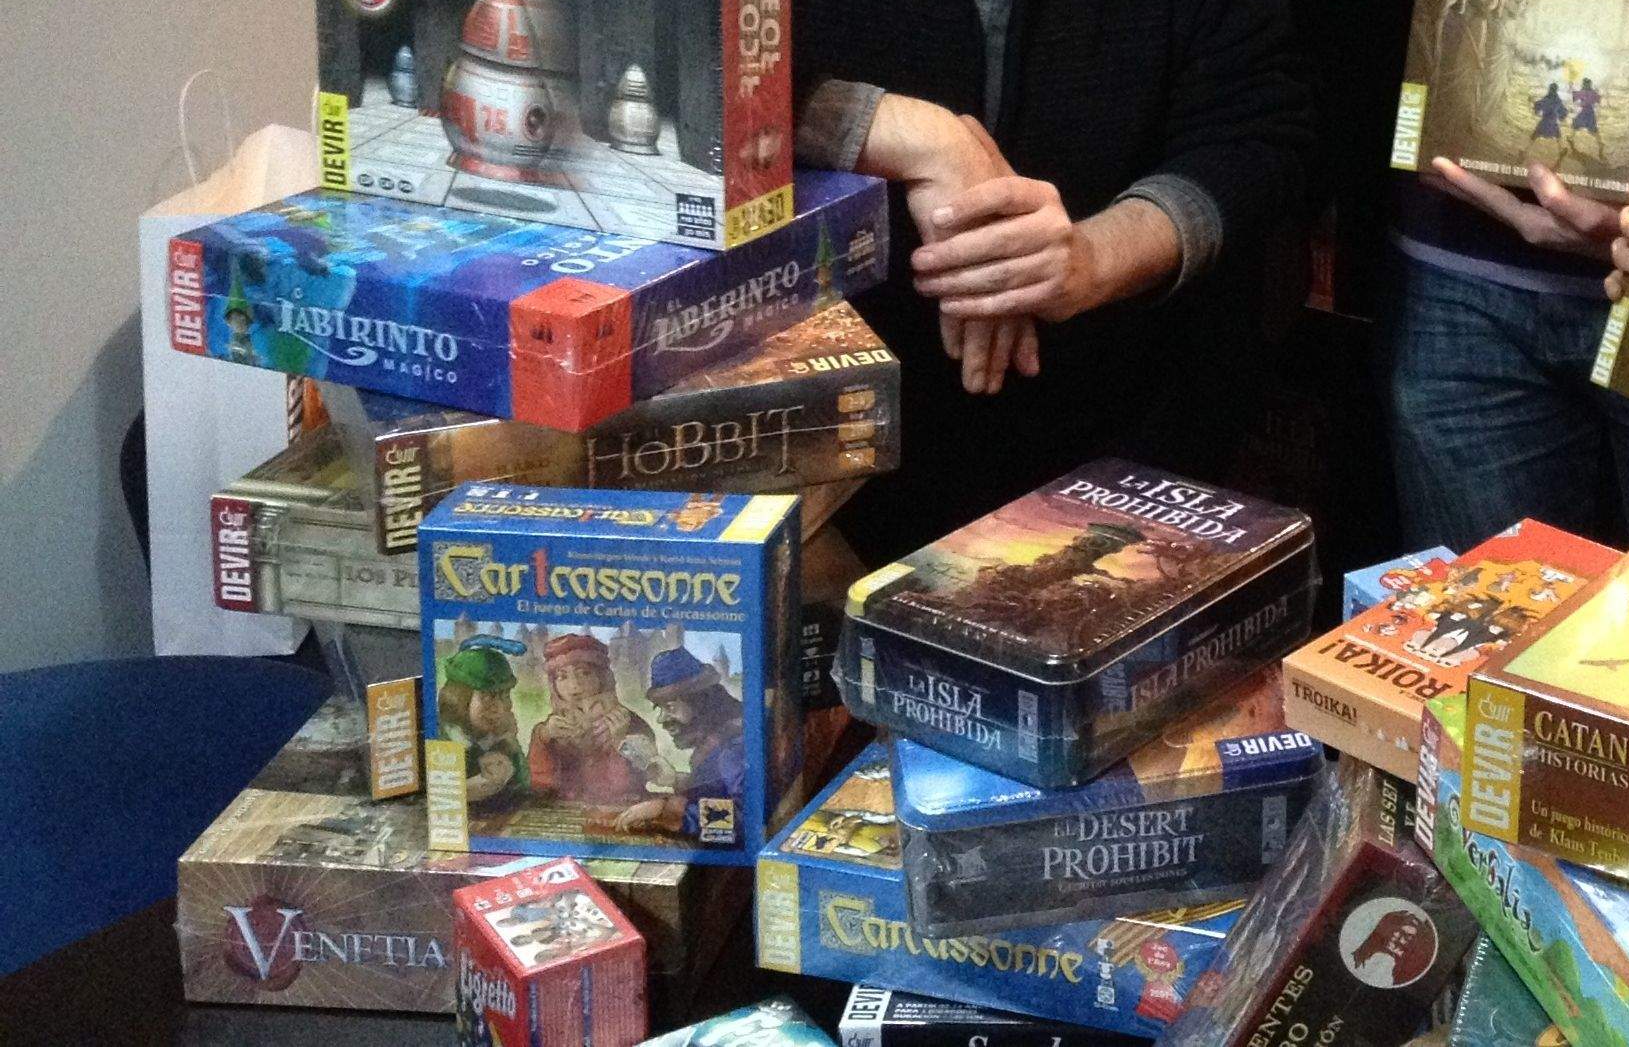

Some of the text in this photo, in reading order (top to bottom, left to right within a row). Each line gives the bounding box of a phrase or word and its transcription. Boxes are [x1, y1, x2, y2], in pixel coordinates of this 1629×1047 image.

[322, 118, 346, 188] DEVIR
[1394, 104, 1422, 166] DEVIR
[173, 265, 199, 348] DEVIR
[276, 295, 459, 364] LABIRINTO
[808, 348, 894, 373] DEVIR
[587, 405, 804, 488] HOBBIT
[381, 465, 423, 550] DEVIR
[1059, 480, 1247, 544] PROHIBIDA
[1118, 475, 1245, 520] LA ISLA
[220, 530, 249, 603] DEVIR
[517, 600, 530, 612] El
[574, 603, 590, 614] de
[594, 604, 637, 618] Cartas
[642, 606, 656, 618] de
[662, 607, 746, 622] Carcassonne
[909, 675, 983, 718] LA ISLA
[1292, 678, 1358, 721] TROIKA!
[1318, 638, 1453, 699] ROIKA!
[379, 709, 416, 789] DEVIR
[892, 692, 1000, 749] PROHIBIDA
[1244, 732, 1312, 755] DEVIR
[1534, 710, 1629, 767] CATAN
[431, 764, 462, 844] DEVIR
[1414, 743, 1438, 851] DEVIR
[1469, 723, 1515, 830] DEVIR
[1077, 806, 1195, 842] DESERT
[1529, 822, 1544, 840] de
[1550, 828, 1586, 854] Klaus
[1531, 799, 1549, 819] Un
[1549, 809, 1582, 831] juego
[1040, 834, 1204, 880] PROHIBIT
[224, 905, 447, 983] VENETIA
[763, 890, 796, 963] DEVIR
[460, 948, 516, 1020] Ligretto
